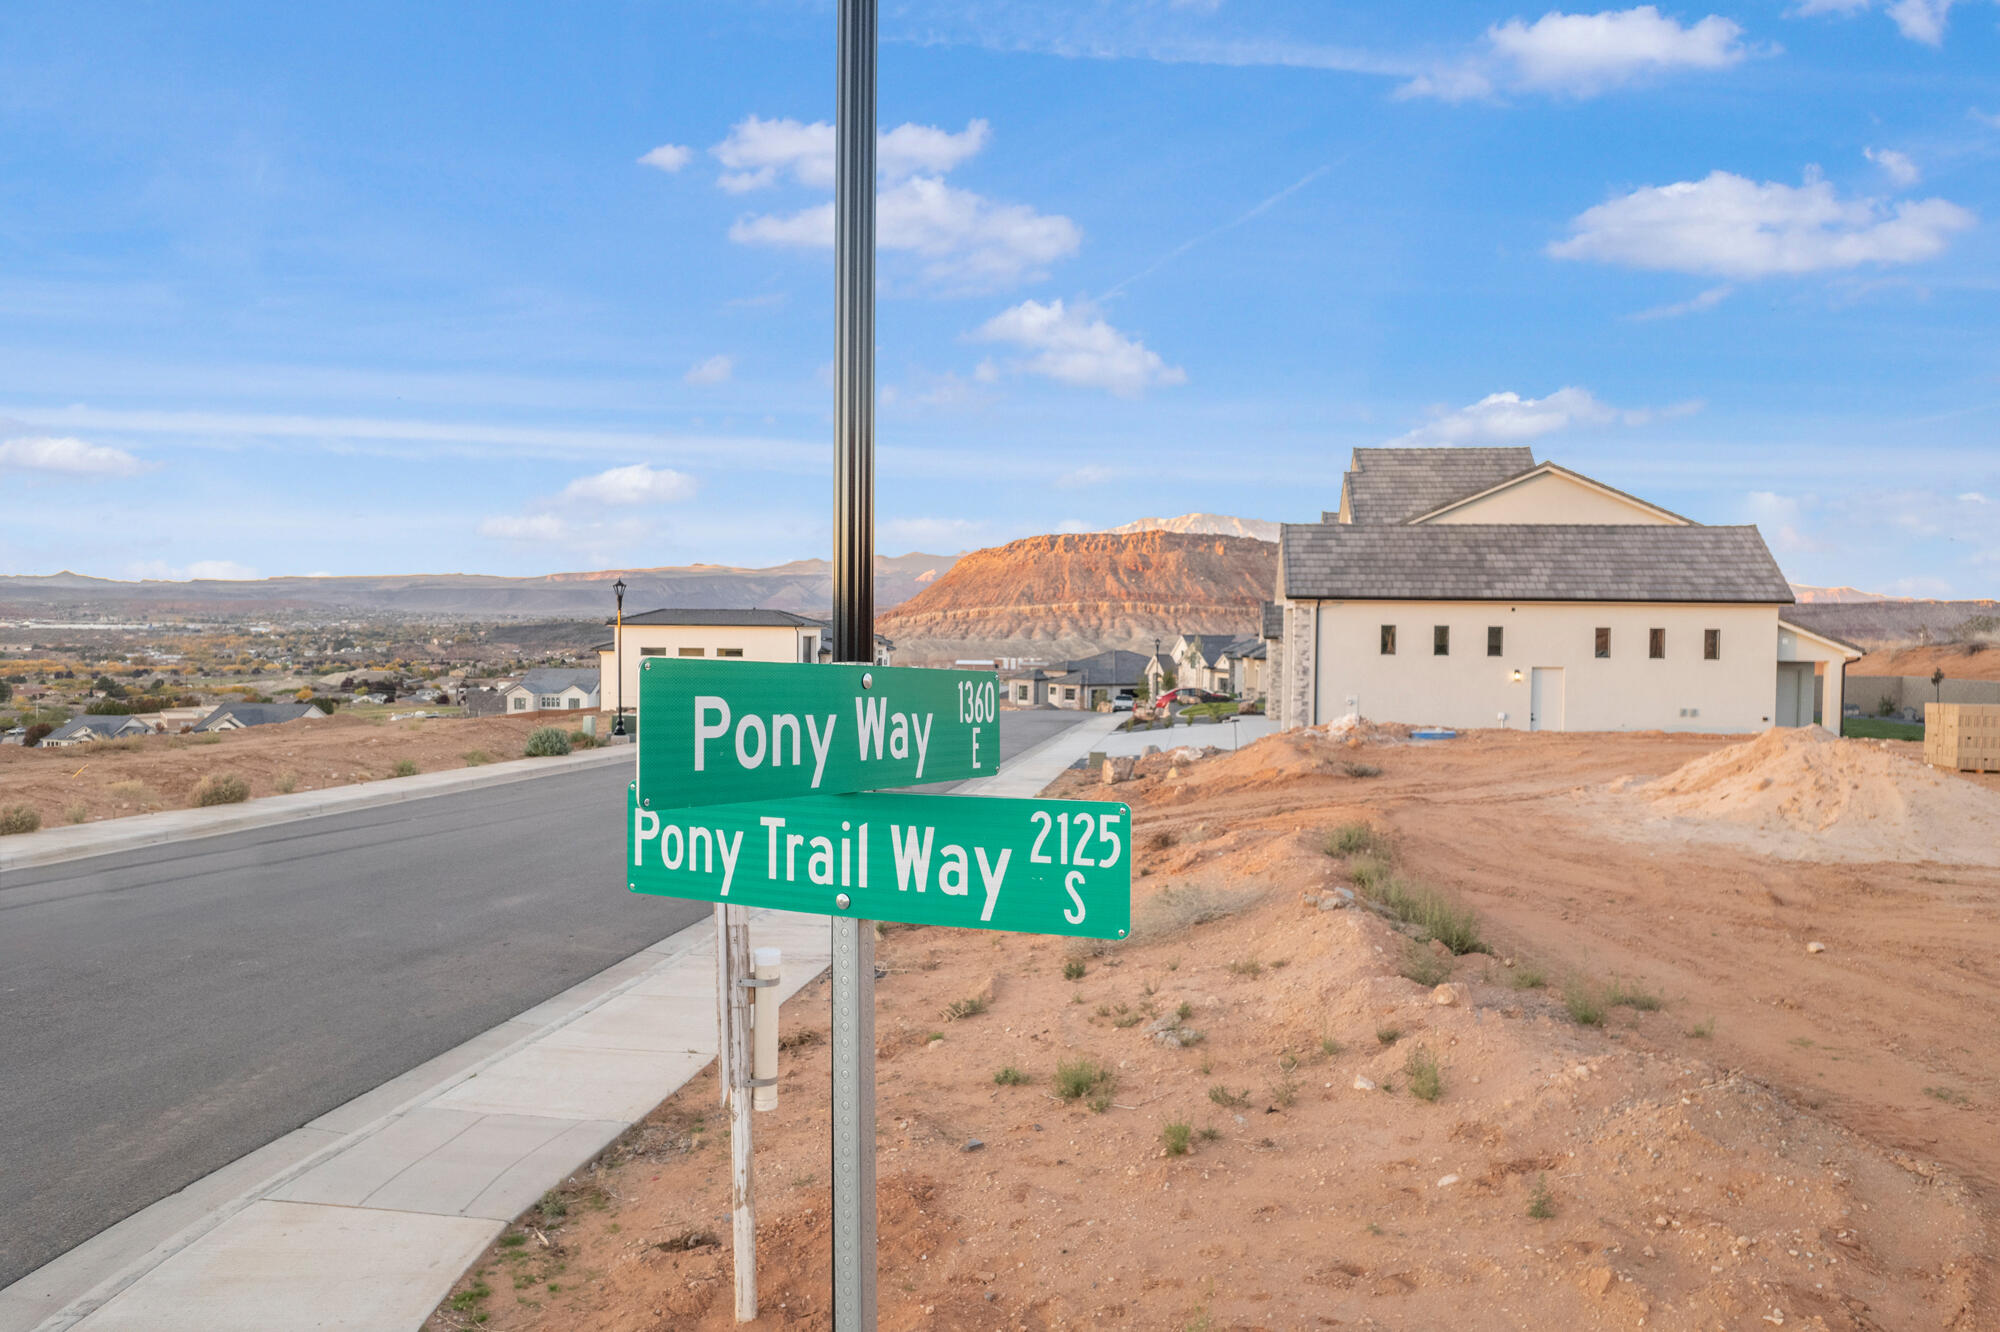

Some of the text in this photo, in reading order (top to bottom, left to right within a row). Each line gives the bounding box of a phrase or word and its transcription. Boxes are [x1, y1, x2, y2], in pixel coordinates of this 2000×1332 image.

[958, 680, 996, 724] 1360
[694, 695, 934, 789] Pony Way
[972, 726, 982, 769] E
[634, 808, 1011, 922] Pony Trail Way
[1030, 811, 1122, 868] 2125
[1063, 871, 1086, 925] S
